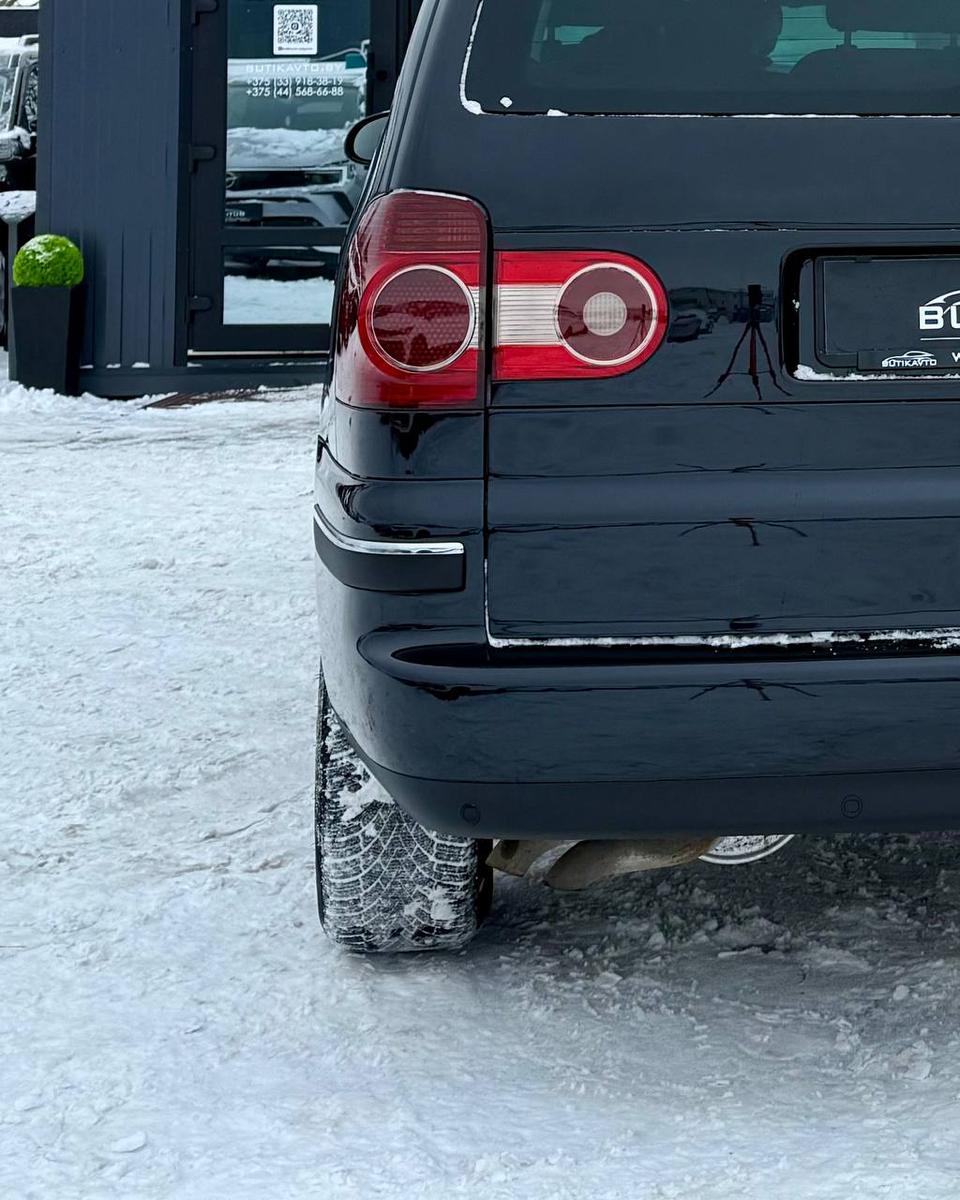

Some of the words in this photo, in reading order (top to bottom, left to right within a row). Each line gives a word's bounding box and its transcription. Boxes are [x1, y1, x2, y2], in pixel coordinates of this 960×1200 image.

[246, 63, 343, 73] BUTIKAVTO.BY
[246, 77, 270, 86] +375
[246, 87, 271, 96] +375
[273, 86, 292, 98] (44)
[295, 87, 344, 96] 568-66-88
[881, 359, 937, 367] BUTIKAVTO
